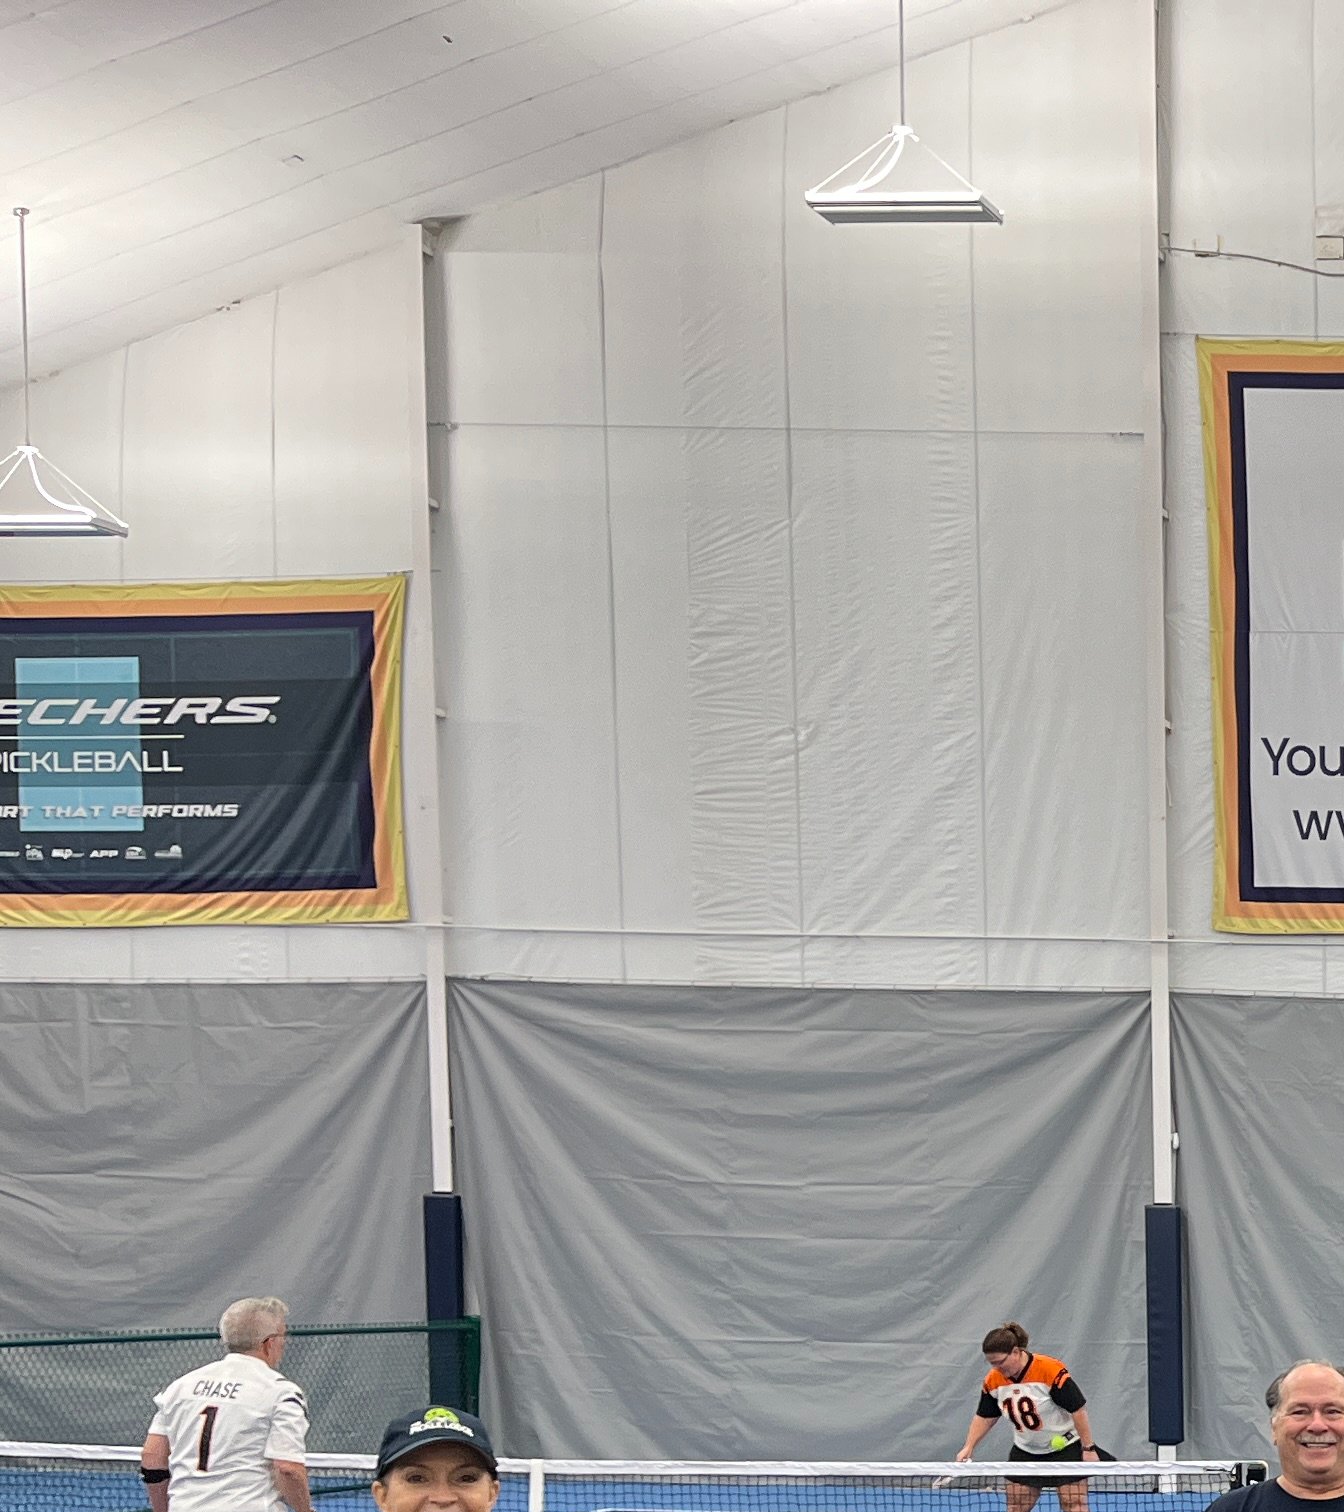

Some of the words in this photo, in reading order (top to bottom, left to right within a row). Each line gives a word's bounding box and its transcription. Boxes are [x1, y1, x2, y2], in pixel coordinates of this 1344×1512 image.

[0, 750, 184, 773] ICKLEBALL
[42, 804, 104, 819] THAT
[112, 803, 240, 819] PERFORMS
[193, 1380, 242, 1399] CHASE
[1002, 1396, 1043, 1433] 18
[196, 1404, 219, 1472] 1
